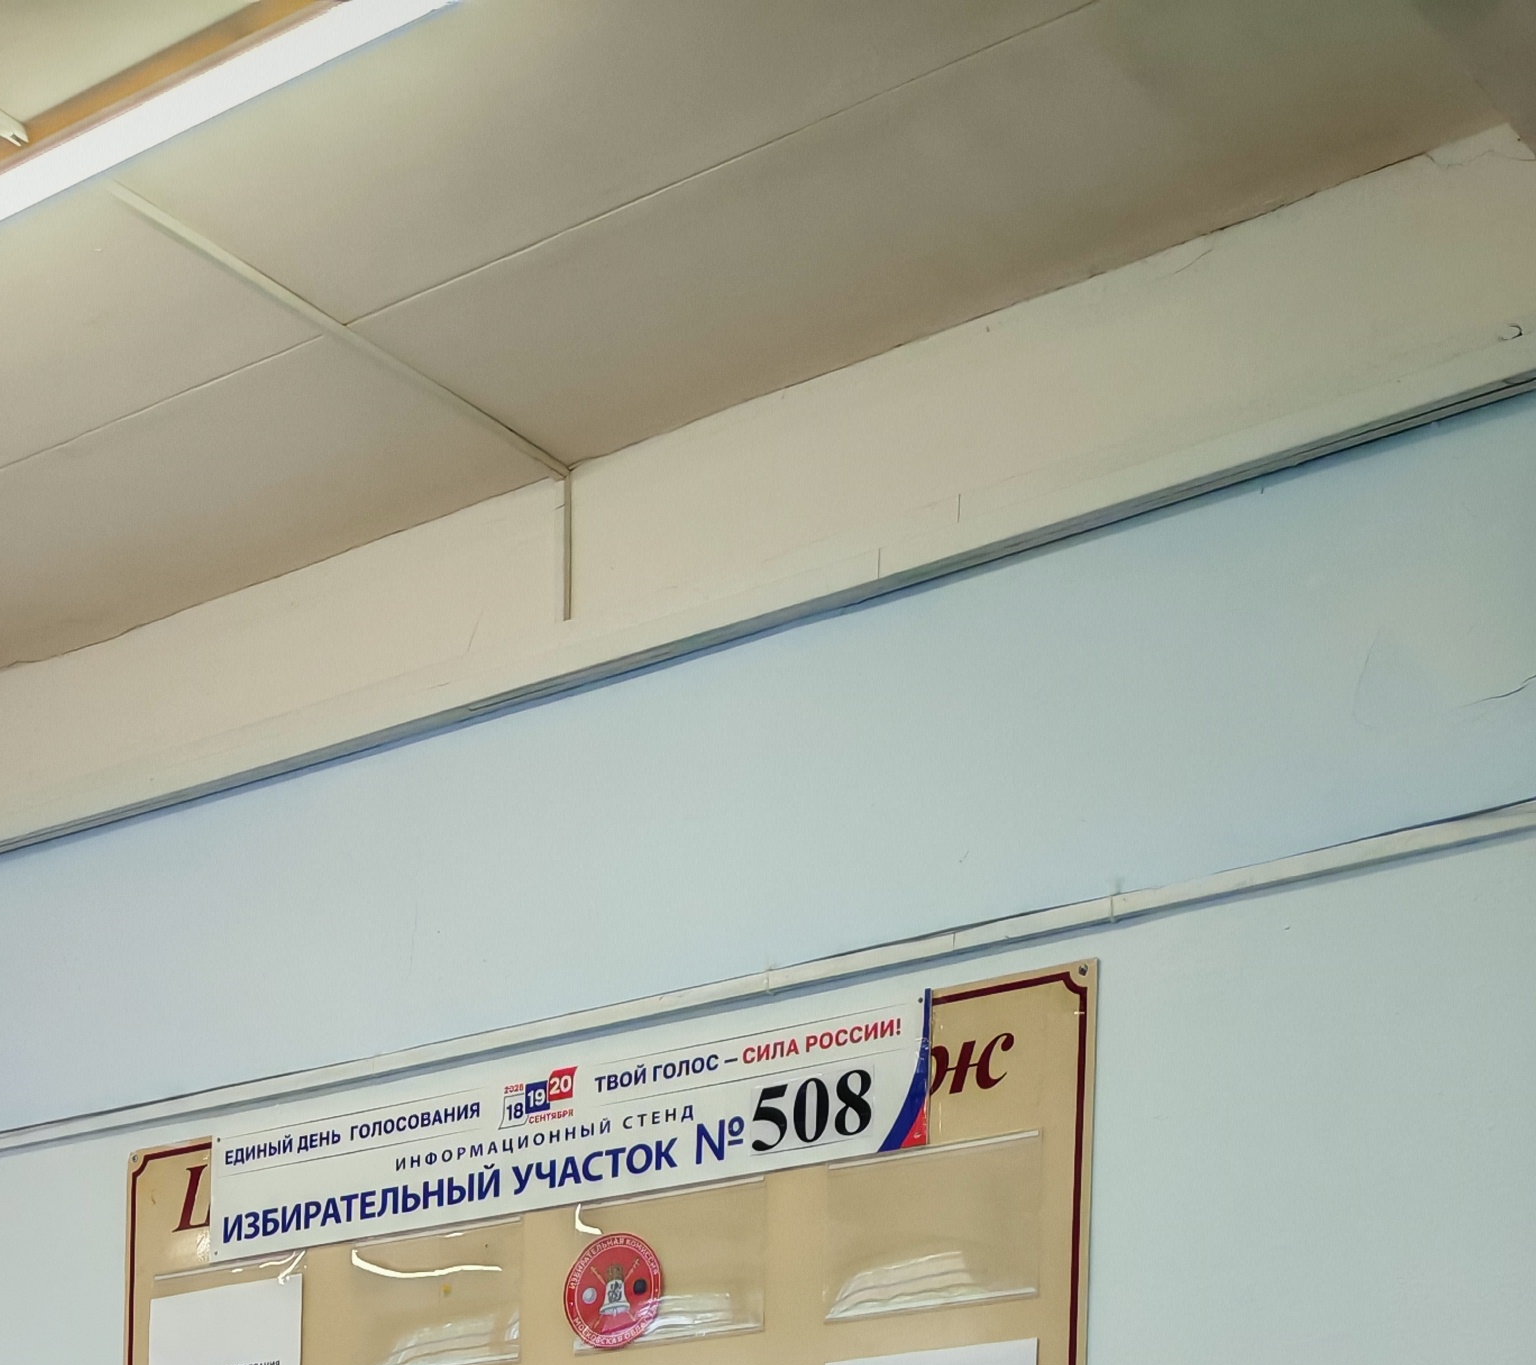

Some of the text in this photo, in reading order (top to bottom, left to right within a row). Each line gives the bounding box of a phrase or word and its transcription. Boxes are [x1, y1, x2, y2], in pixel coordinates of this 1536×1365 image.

[594, 1064, 646, 1093] ТВОЙ
[652, 1053, 720, 1082] ГОЛОС
[742, 1038, 799, 1064] СИЛА
[805, 1018, 902, 1053] РОССИИ!
[506, 1075, 572, 1121] 18 19 20
[528, 1109, 574, 1124] СЕНТЯБРЯ
[222, 1163, 501, 1244] ИЗБИРАТЕЛЬНЫЙ
[512, 1136, 679, 1196] УЧАСТОК
[751, 1069, 872, 1152] 508
[225, 1102, 481, 1165] ЕДИНЫЙ ДЕНЬ ГОЛОСОВАНИЯ
[395, 1104, 695, 1172] ИНФОРМАЦИОННЫЙ СТЕНД
